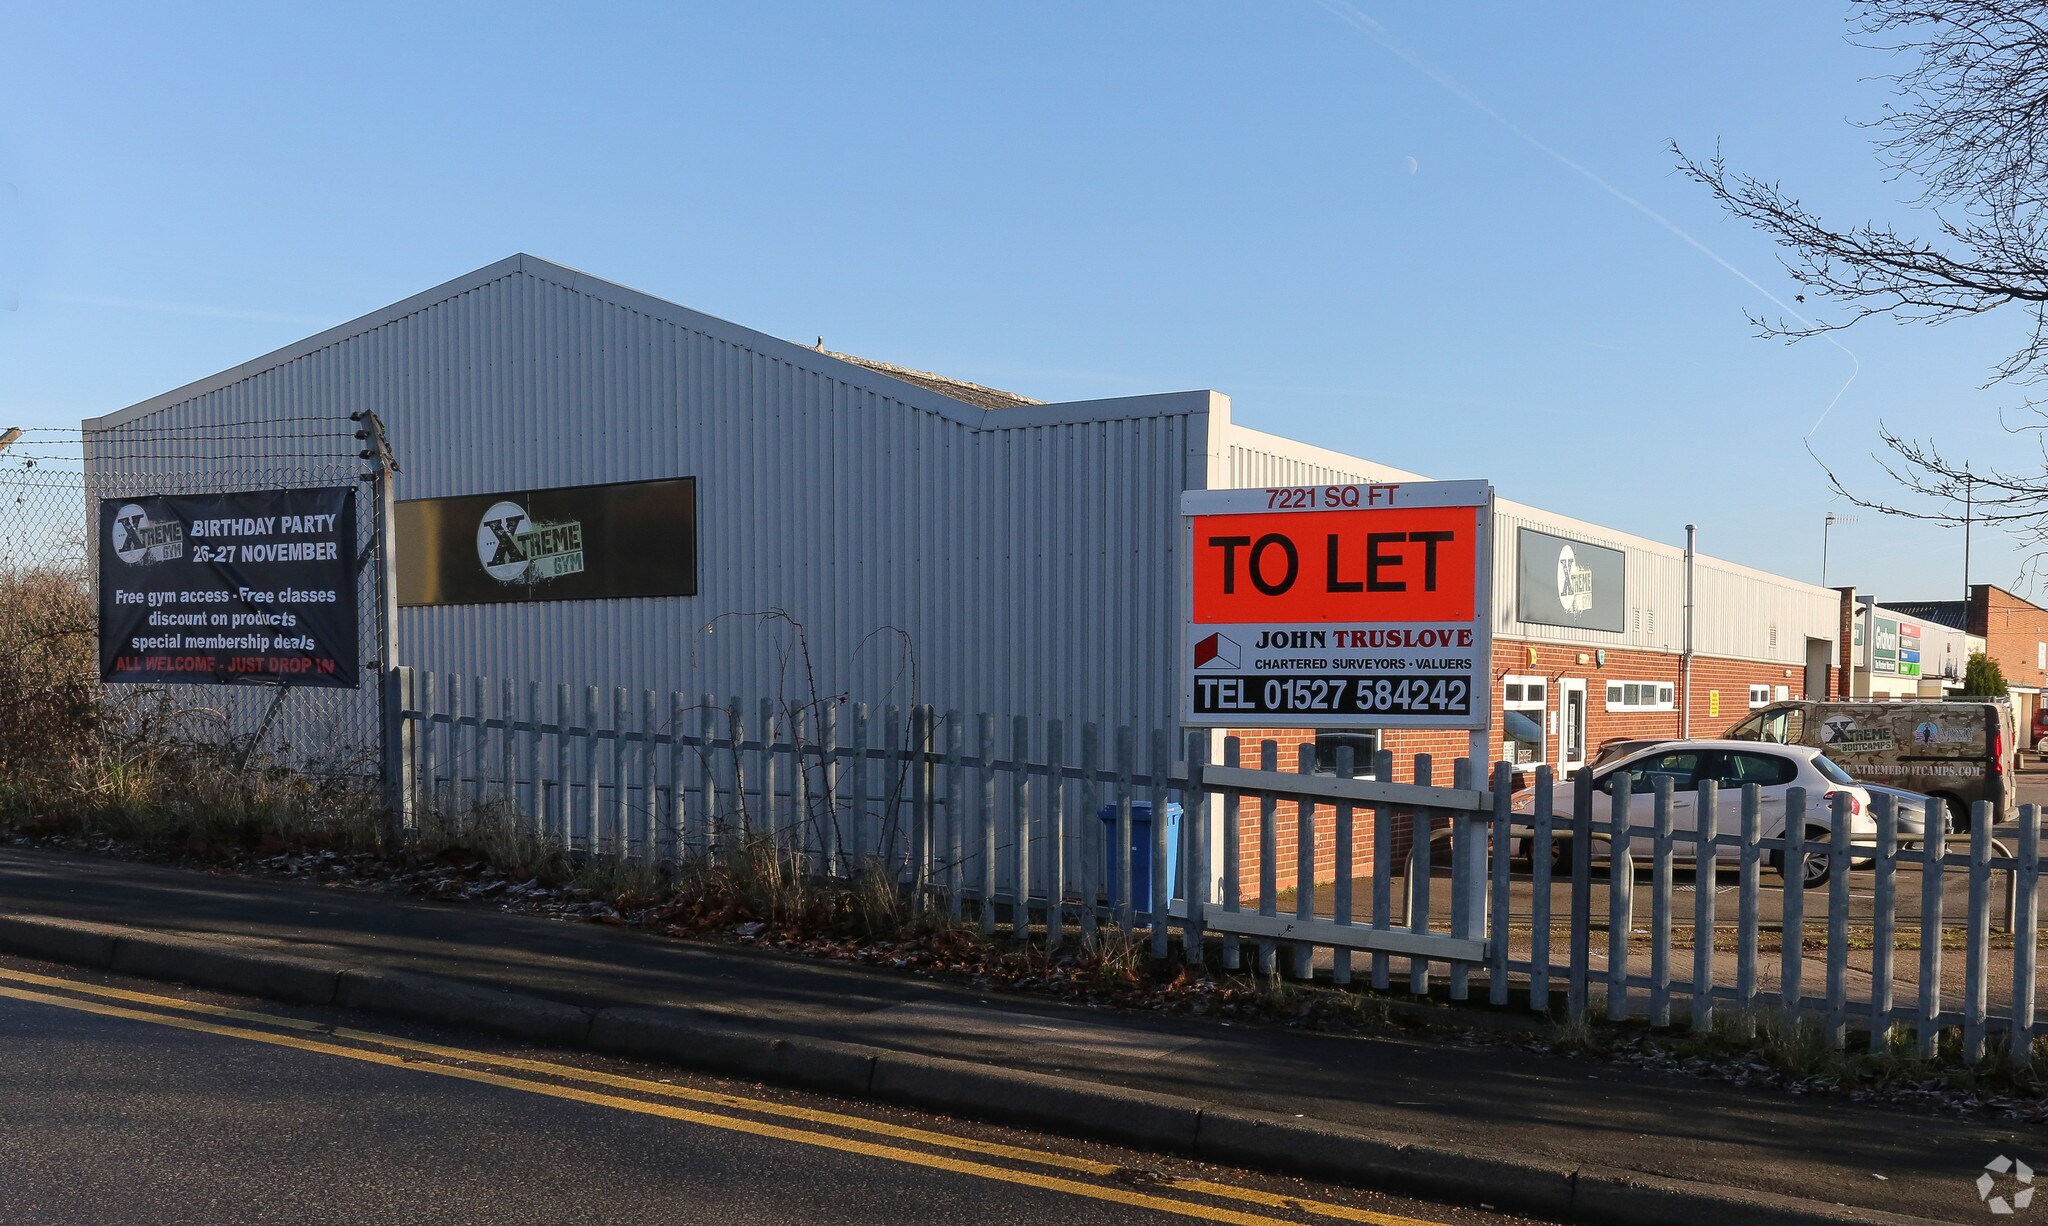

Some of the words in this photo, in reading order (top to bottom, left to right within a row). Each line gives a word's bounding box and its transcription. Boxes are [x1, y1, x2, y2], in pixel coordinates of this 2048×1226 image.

[1266, 488, 1315, 508] 7221
[1324, 486, 1360, 508] SQ
[1368, 485, 1399, 506] FT
[118, 514, 182, 553] XTREME
[190, 517, 276, 537] BIRTHDAY
[281, 514, 337, 534] PARTY
[484, 515, 581, 567] XTREME
[192, 545, 237, 563] 26-27
[241, 542, 338, 563] NOVEMBER
[554, 554, 582, 575] GYM
[1208, 532, 1299, 596] TO
[1326, 531, 1455, 592] LET
[115, 589, 145, 604] Free
[148, 592, 177, 607] gym
[180, 591, 229, 604] access
[238, 587, 274, 604] Free
[278, 588, 336, 603] classes
[149, 612, 208, 626] discount
[210, 614, 228, 626] on
[232, 611, 297, 629] products
[131, 634, 181, 652] special
[185, 634, 270, 652] membership
[273, 634, 315, 651] deals
[1255, 630, 1327, 649] JOHN
[1333, 628, 1474, 649] TRUSLOVE
[116, 656, 142, 671] ALL
[145, 656, 216, 672] WELCOME
[227, 658, 265, 673] JUST
[269, 657, 312, 673] DROP
[316, 658, 335, 673] IN
[1255, 658, 1328, 670] CHARTERED
[1332, 658, 1406, 670] SURVEYORS
[1415, 657, 1472, 670] VALUERS
[1198, 679, 1255, 709] TEL
[1263, 679, 1348, 710] 01527
[1356, 679, 1466, 711] 584242
[1825, 721, 1891, 744] XTREME
